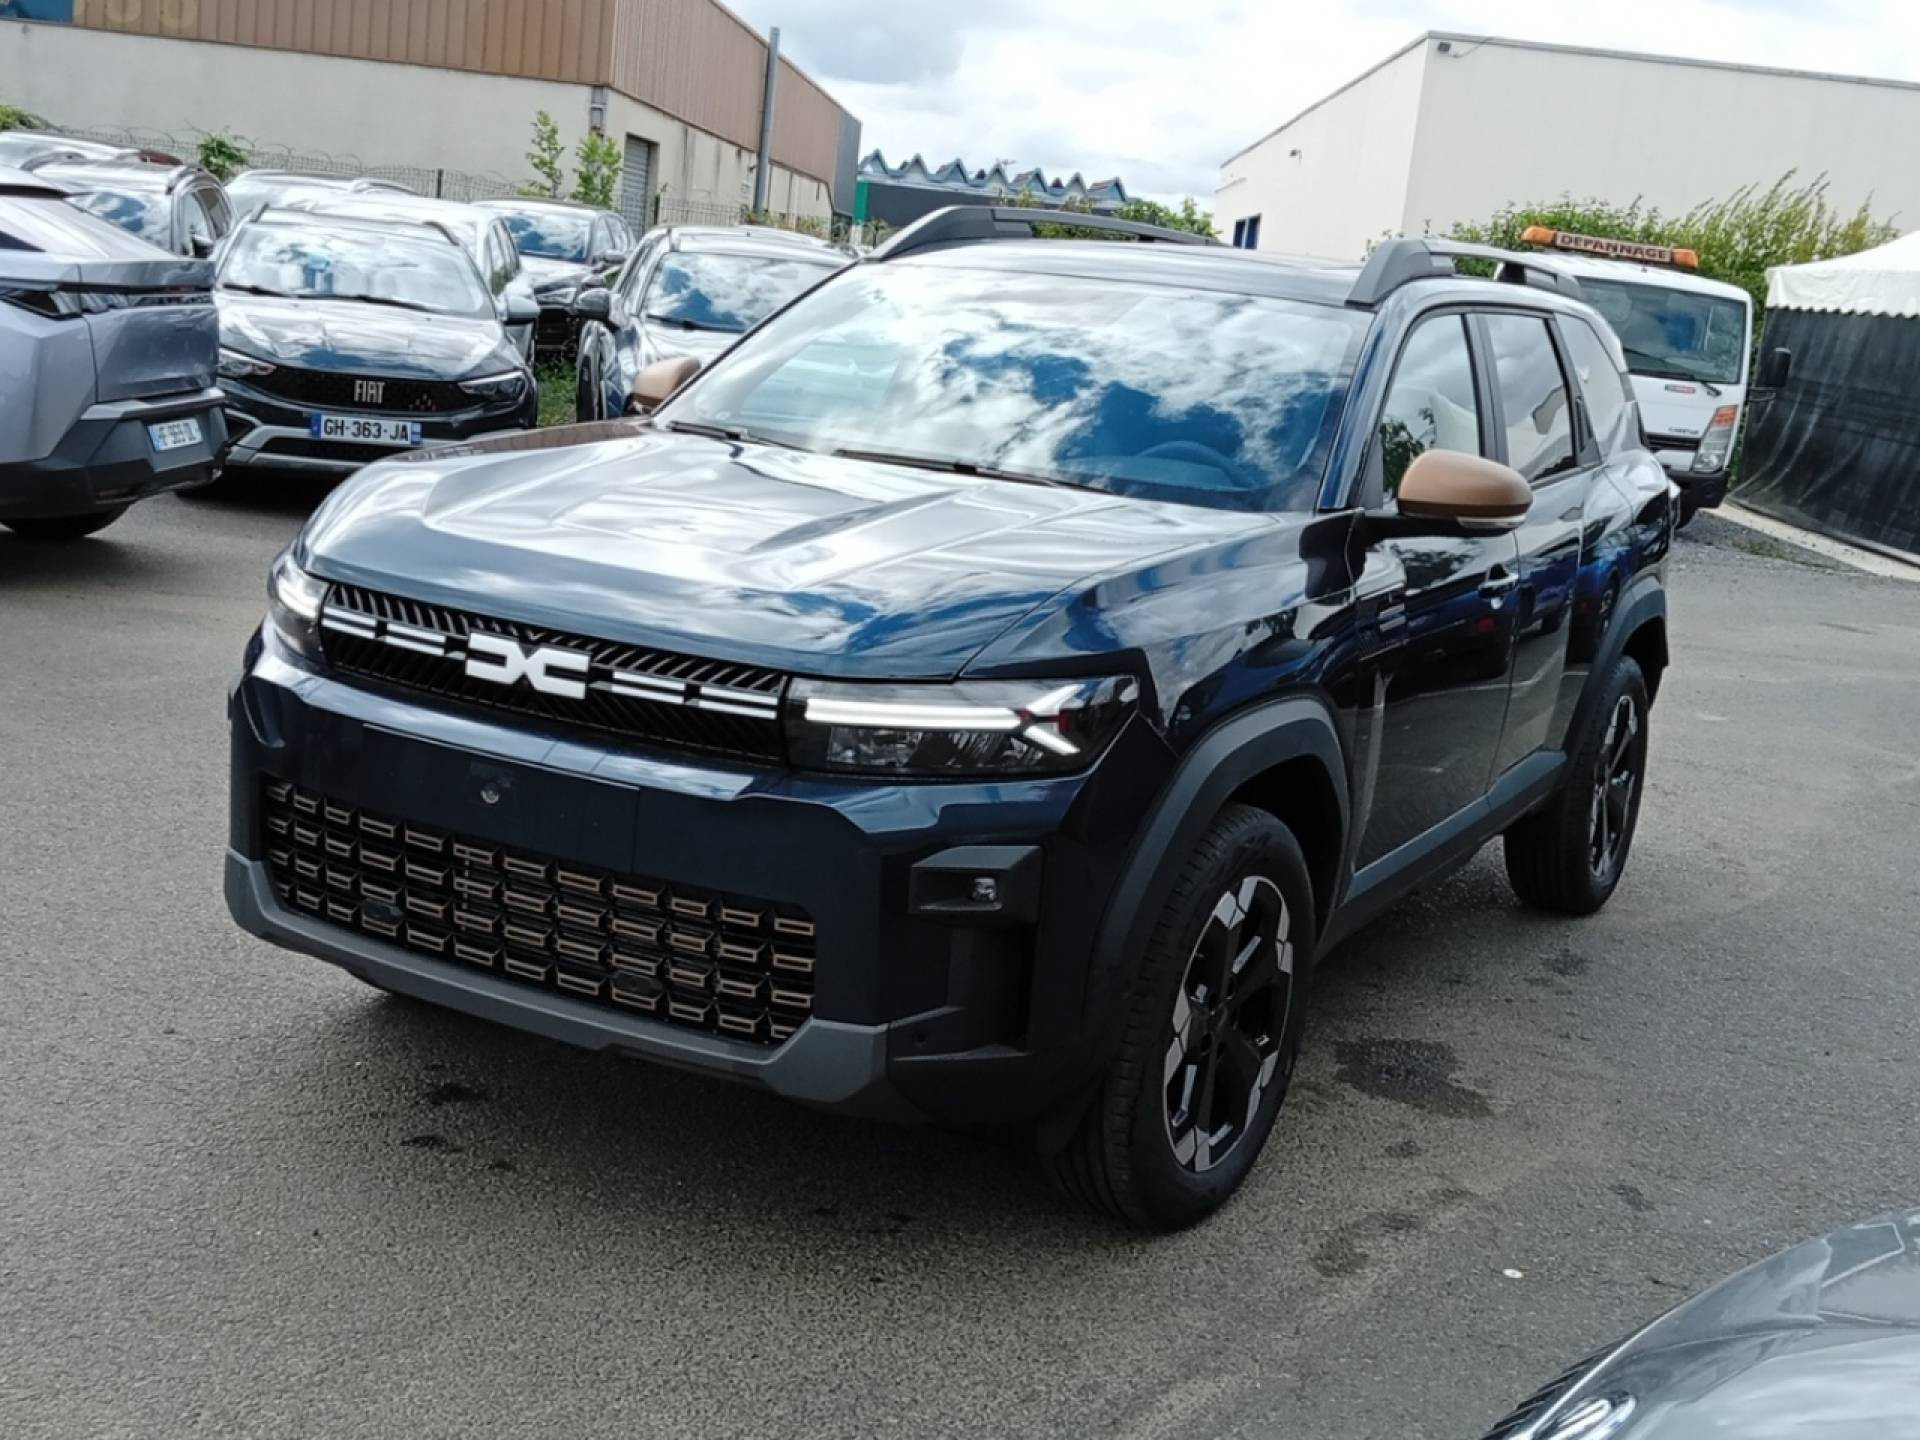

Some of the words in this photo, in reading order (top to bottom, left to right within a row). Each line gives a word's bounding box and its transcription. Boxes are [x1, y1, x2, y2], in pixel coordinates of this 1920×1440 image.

[1560, 235, 1667, 259] DEPANNAGE
[353, 380, 385, 404] FIAT
[323, 418, 409, 442] GH-363-JA
